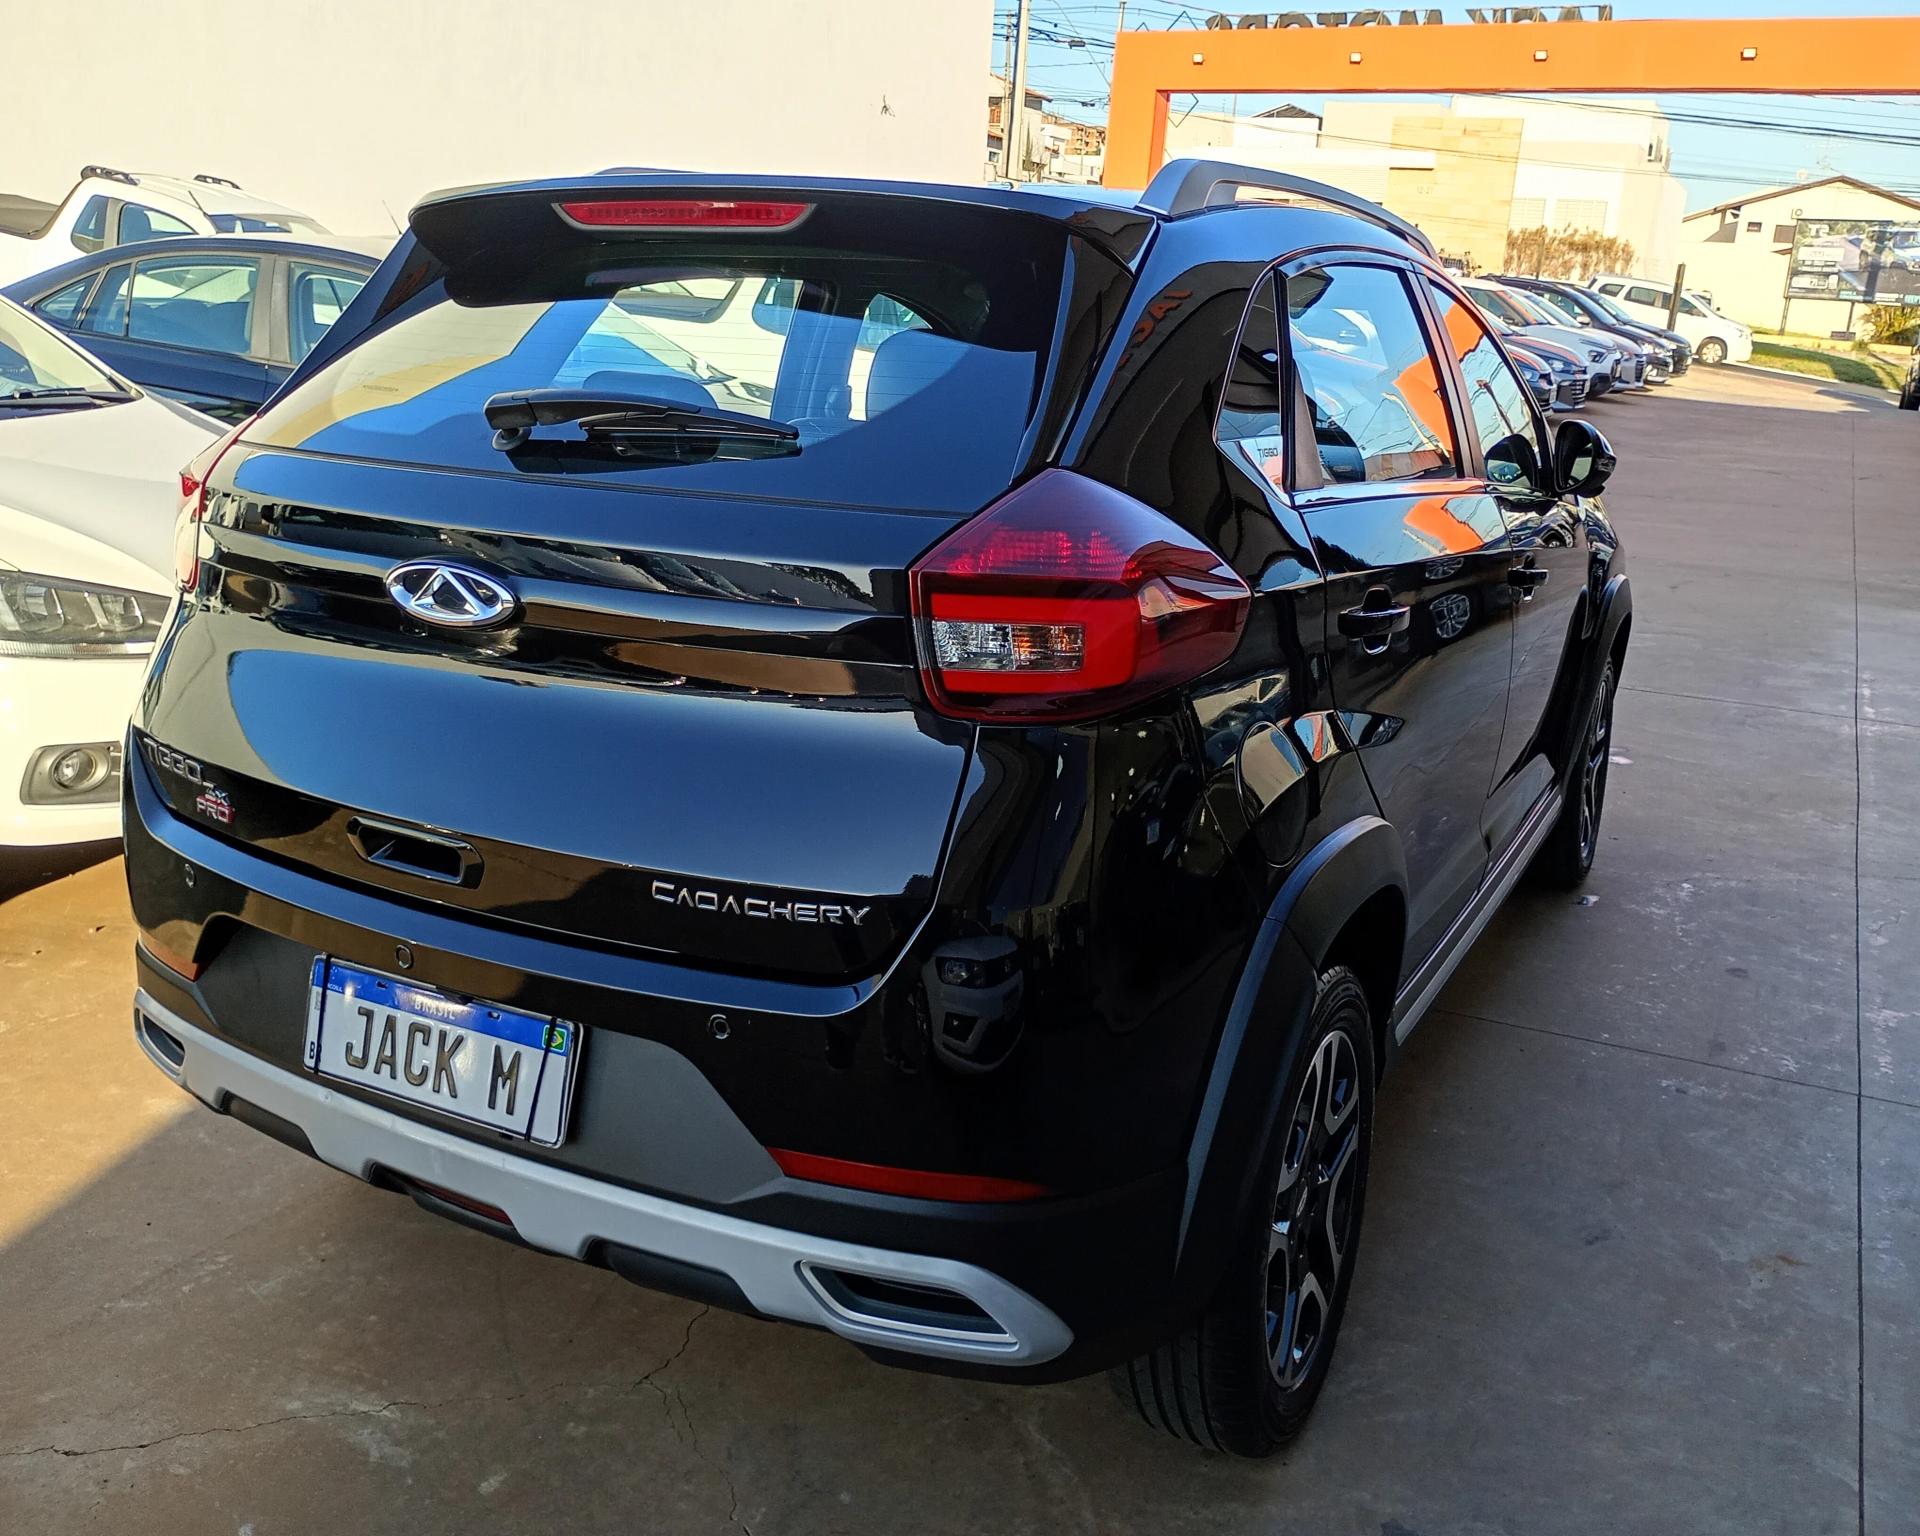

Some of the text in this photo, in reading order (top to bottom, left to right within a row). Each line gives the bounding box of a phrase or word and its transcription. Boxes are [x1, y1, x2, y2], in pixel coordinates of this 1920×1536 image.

[143, 737, 202, 786] TIGGO
[196, 797, 232, 824] PRO
[414, 994, 456, 1020] BRASIL
[345, 1005, 522, 1117] JACK M
